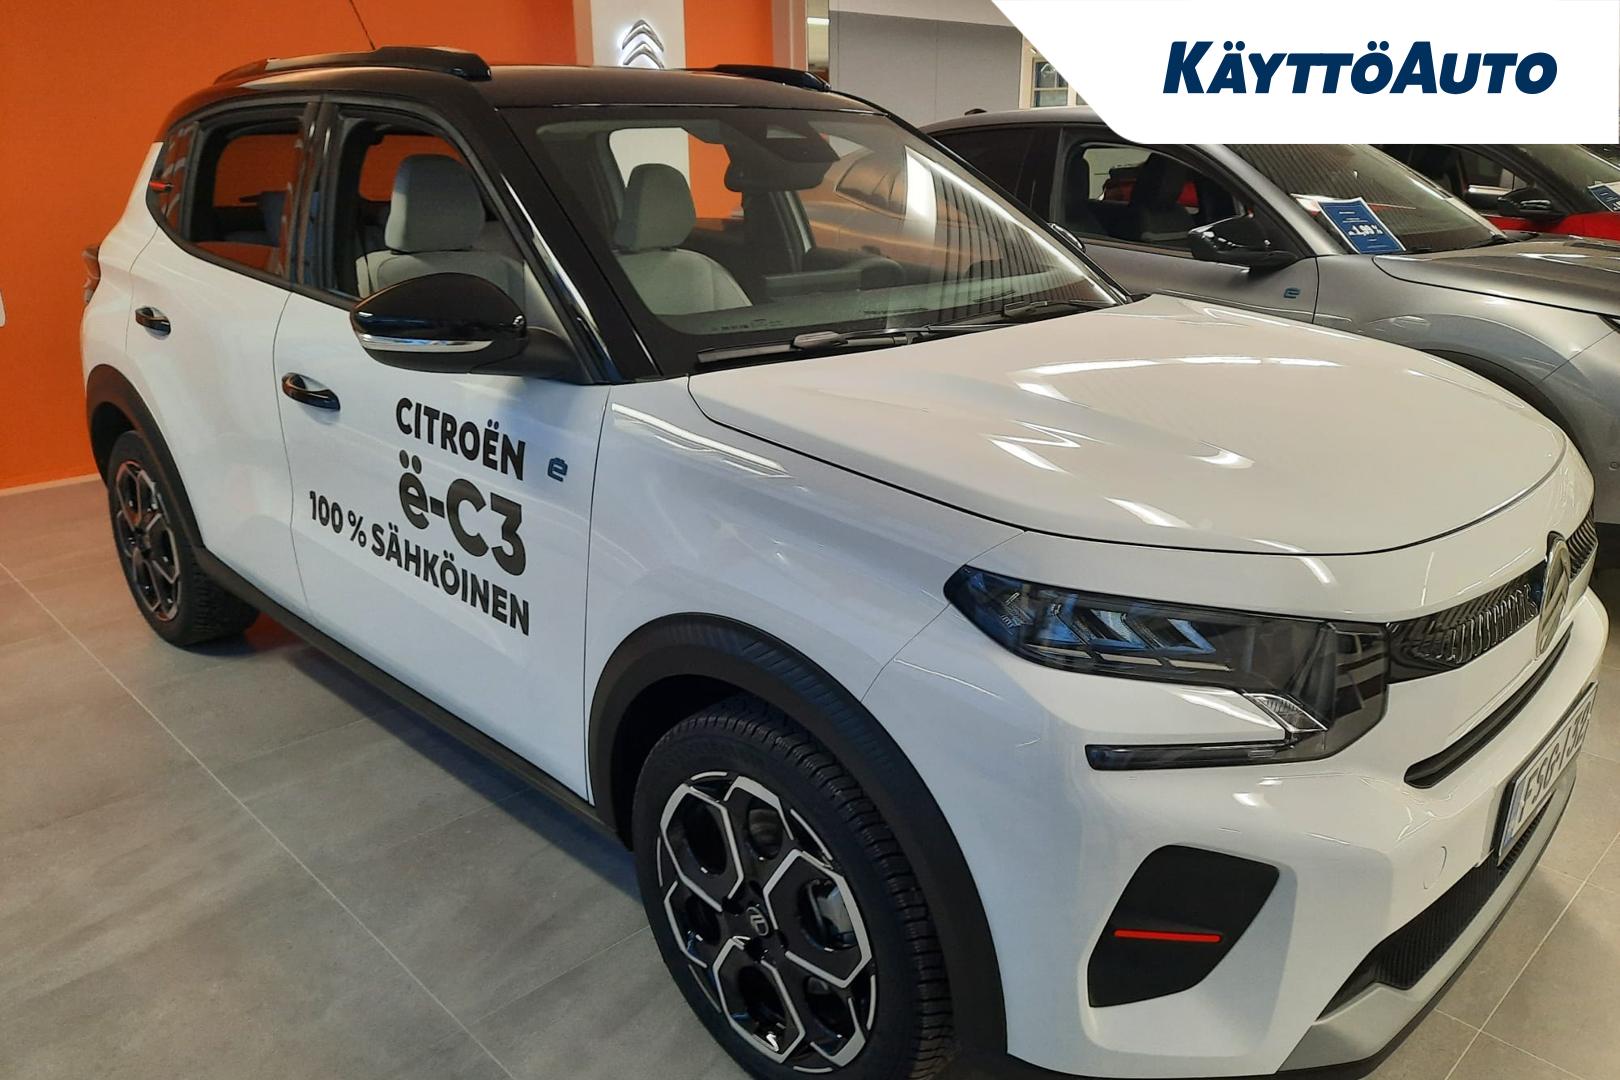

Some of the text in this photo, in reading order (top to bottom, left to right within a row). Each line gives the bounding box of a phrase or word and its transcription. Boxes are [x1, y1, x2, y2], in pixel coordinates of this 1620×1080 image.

[395, 397, 526, 481] CITROËN
[398, 449, 527, 577] ë-C3
[371, 521, 530, 637] SÄHKÖINEN
